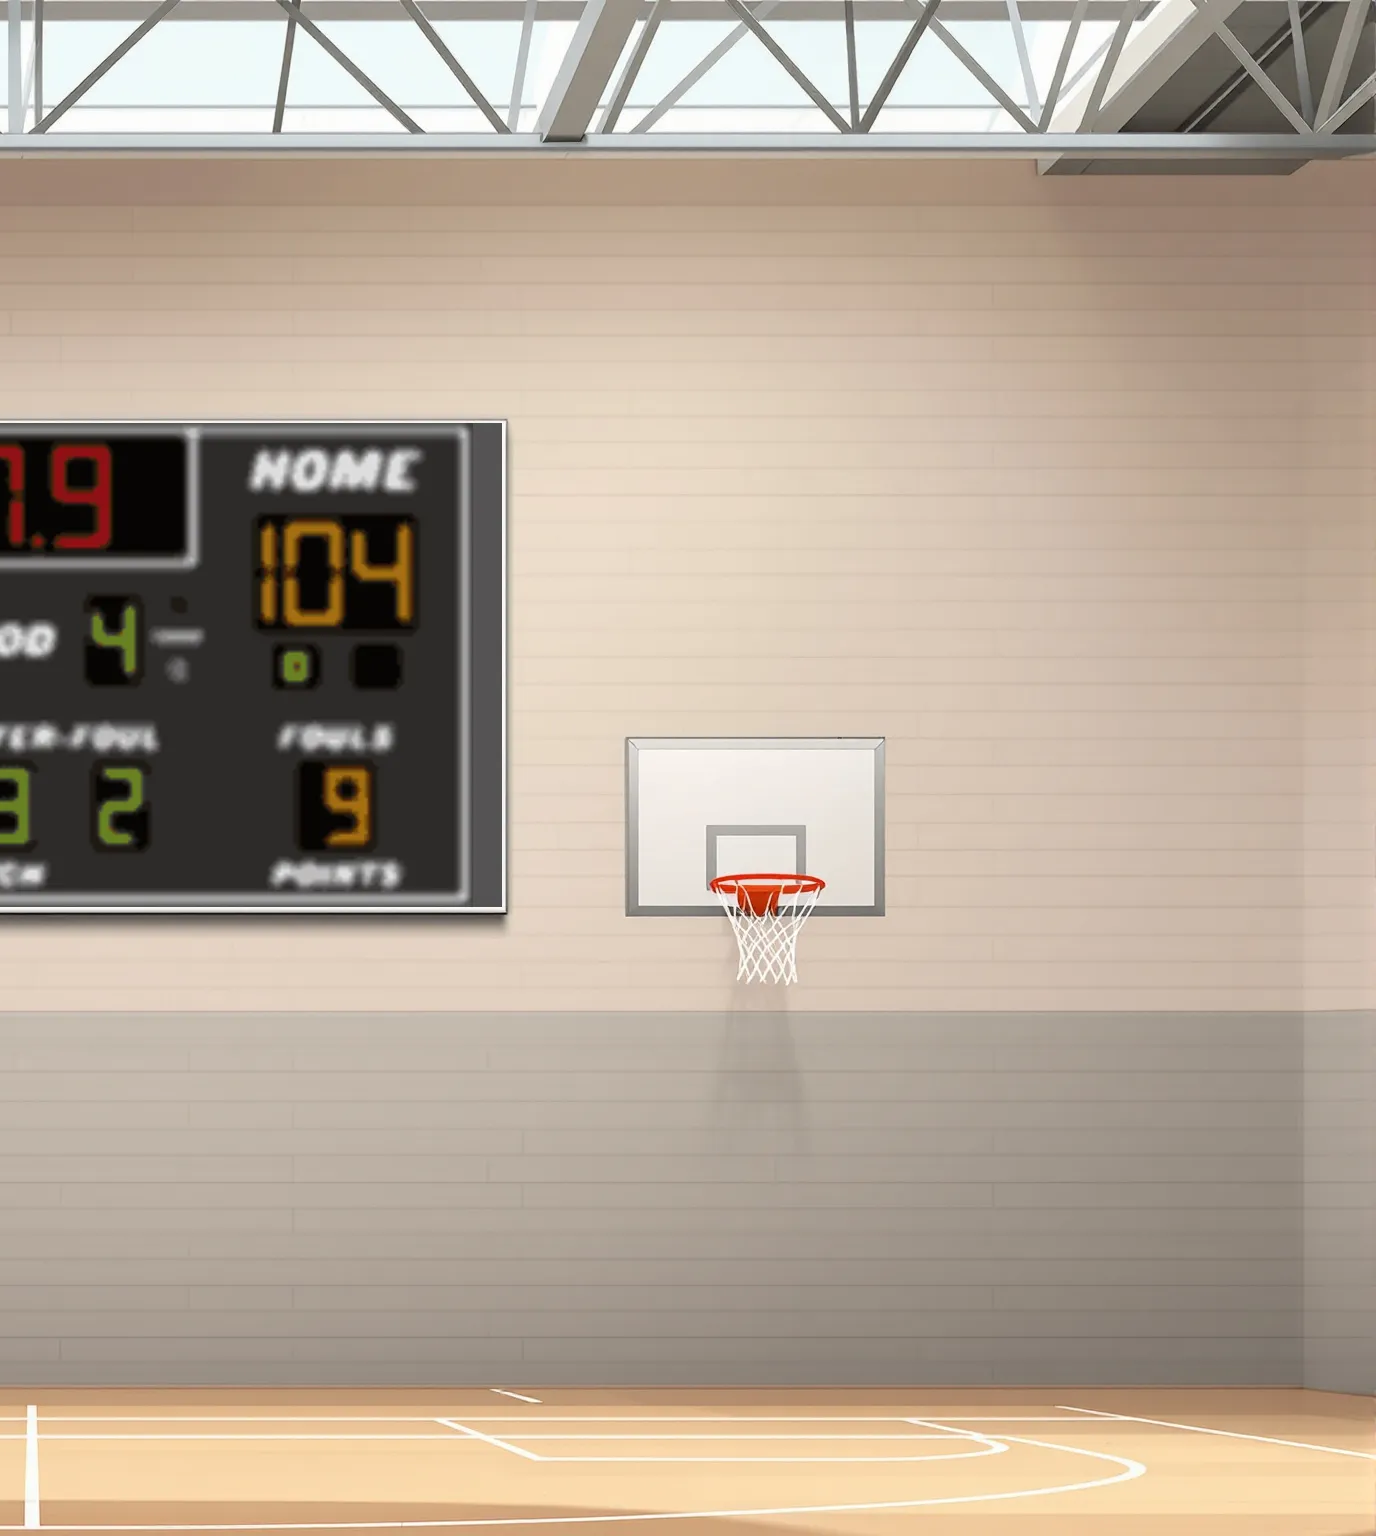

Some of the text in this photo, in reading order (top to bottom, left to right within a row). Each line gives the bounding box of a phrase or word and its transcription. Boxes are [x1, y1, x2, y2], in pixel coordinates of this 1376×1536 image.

[248, 447, 422, 493] HOME
[261, 520, 413, 626] 104
[91, 605, 136, 674] 4
[277, 722, 394, 753] FOULS
[98, 767, 143, 844] 2
[324, 766, 371, 846] 9
[269, 860, 402, 890] POINTS
